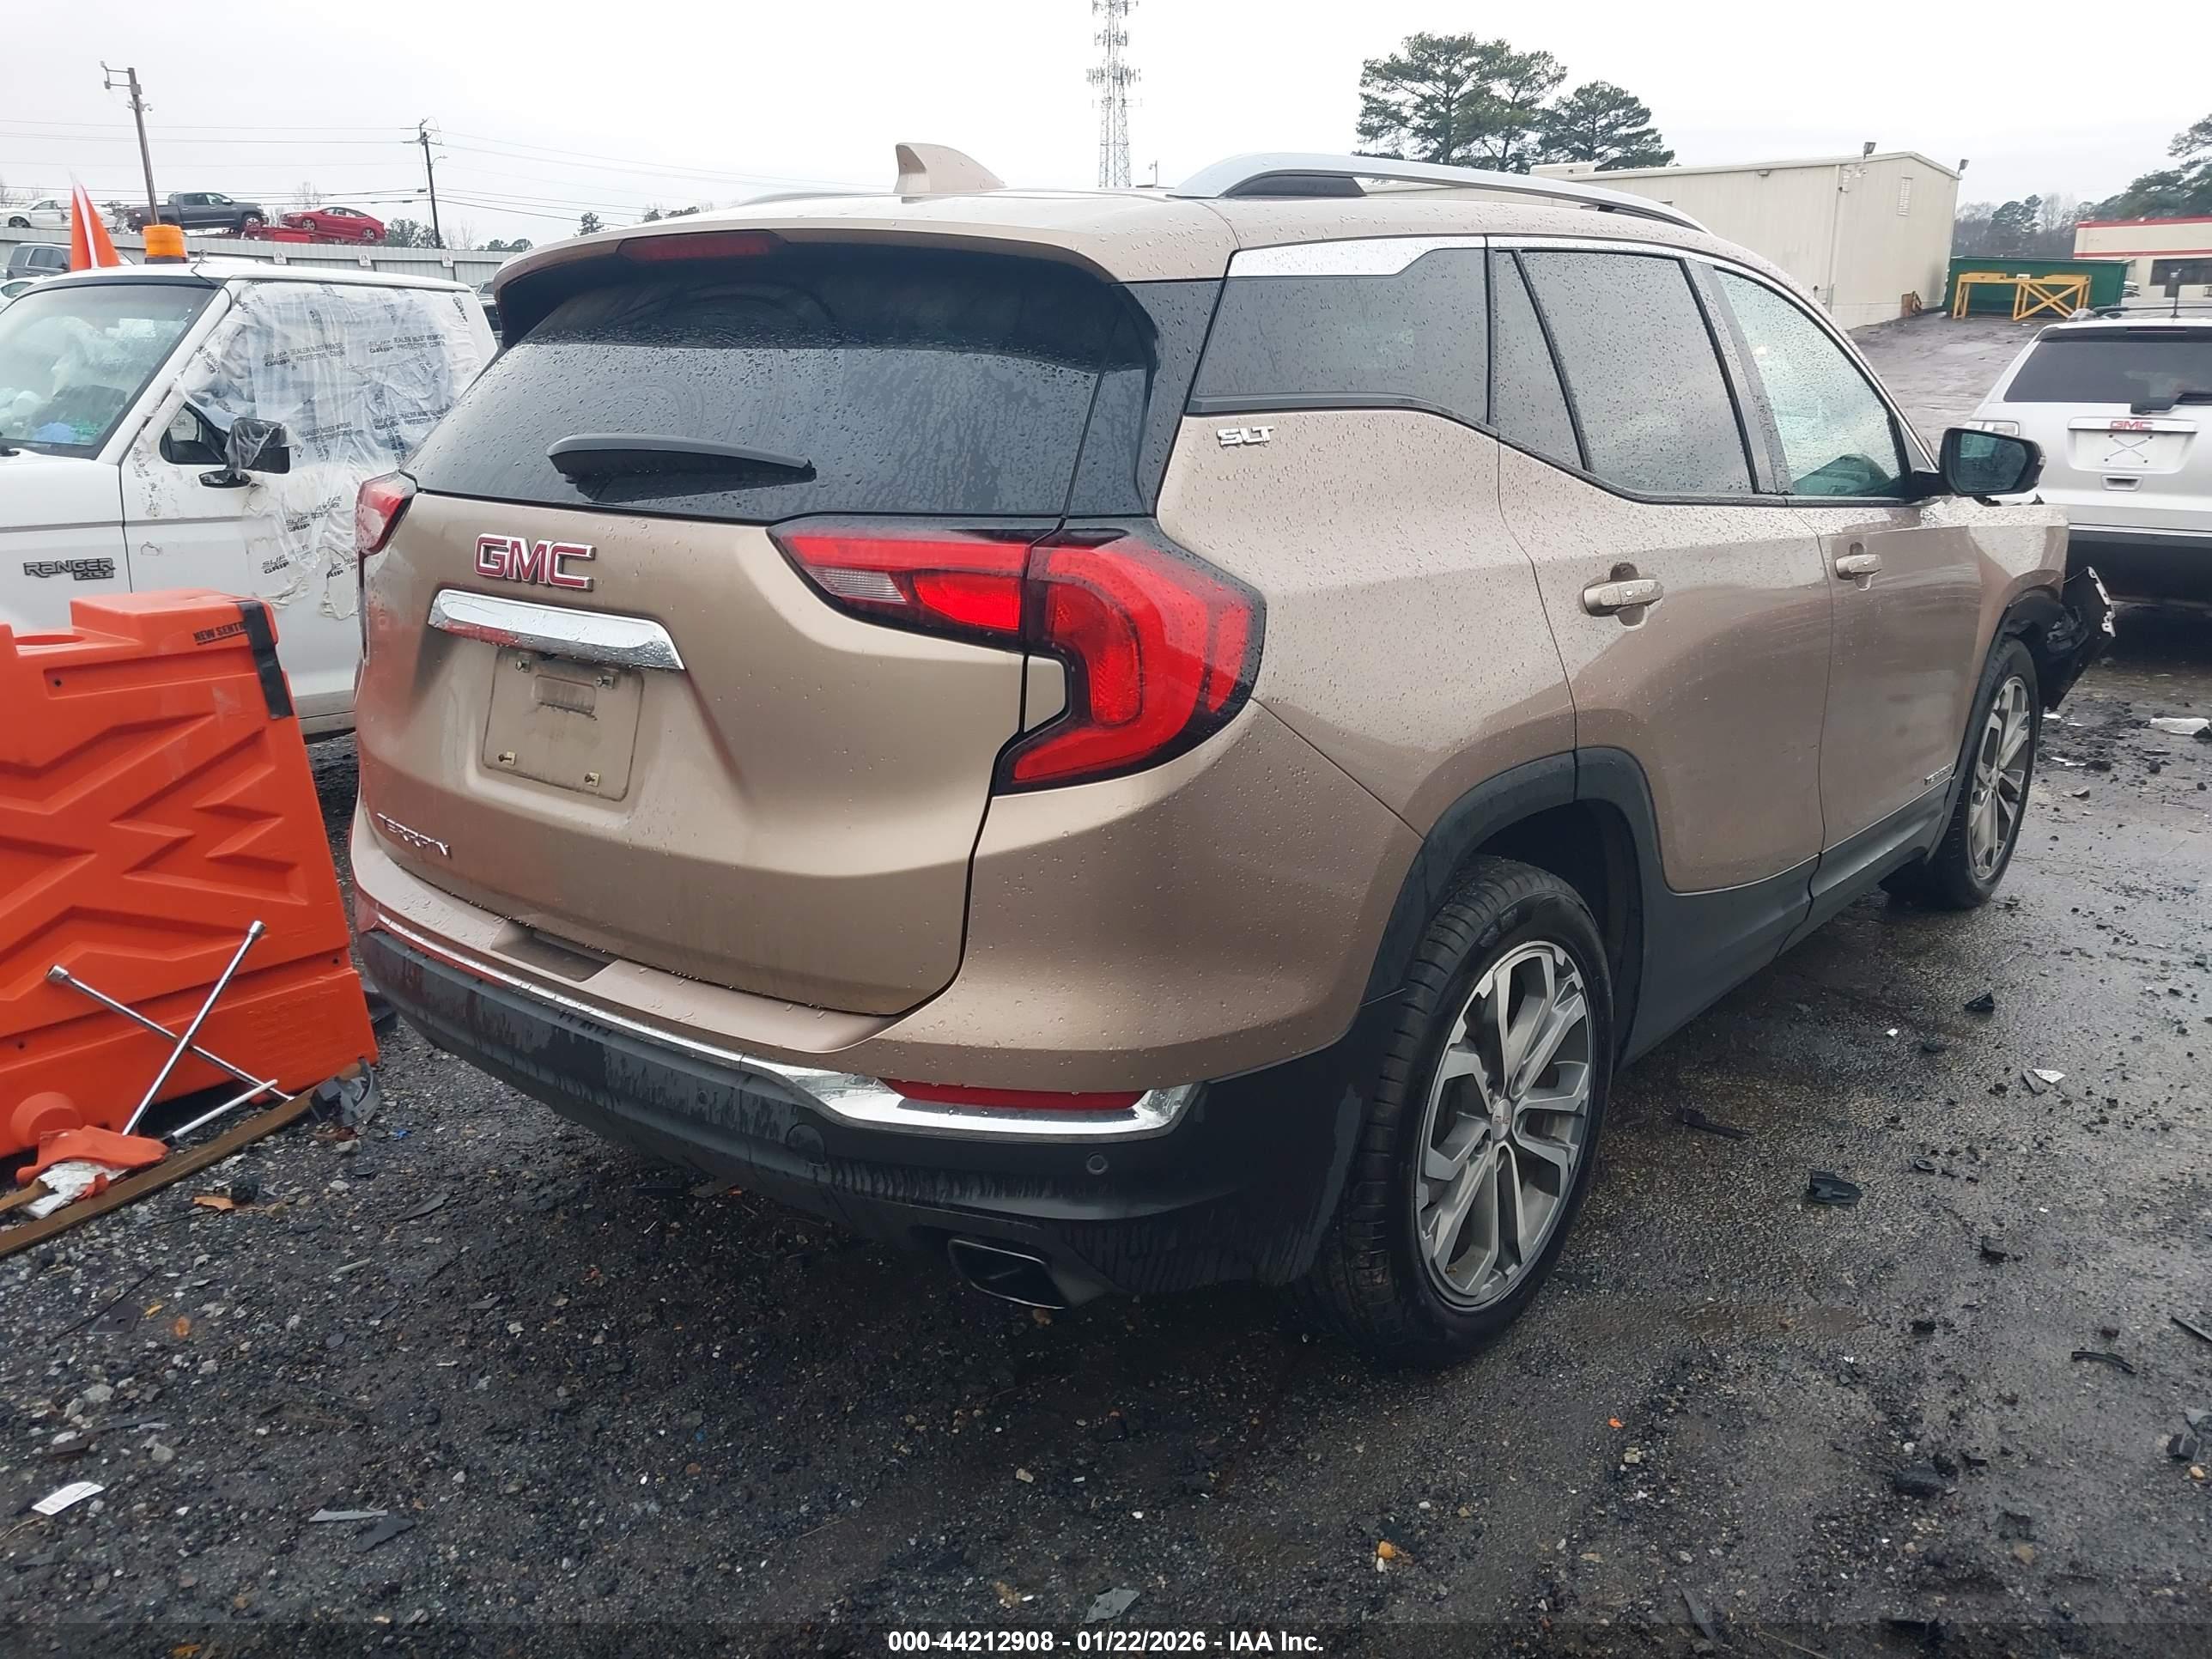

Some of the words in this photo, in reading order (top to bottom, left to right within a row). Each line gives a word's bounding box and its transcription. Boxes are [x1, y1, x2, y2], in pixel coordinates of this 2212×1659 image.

[2109, 419, 2154, 431] GMC
[1216, 425, 1274, 447] SLT
[261, 554, 286, 567] SLIP
[473, 532, 597, 592] GMC
[264, 561, 289, 574] GRIP
